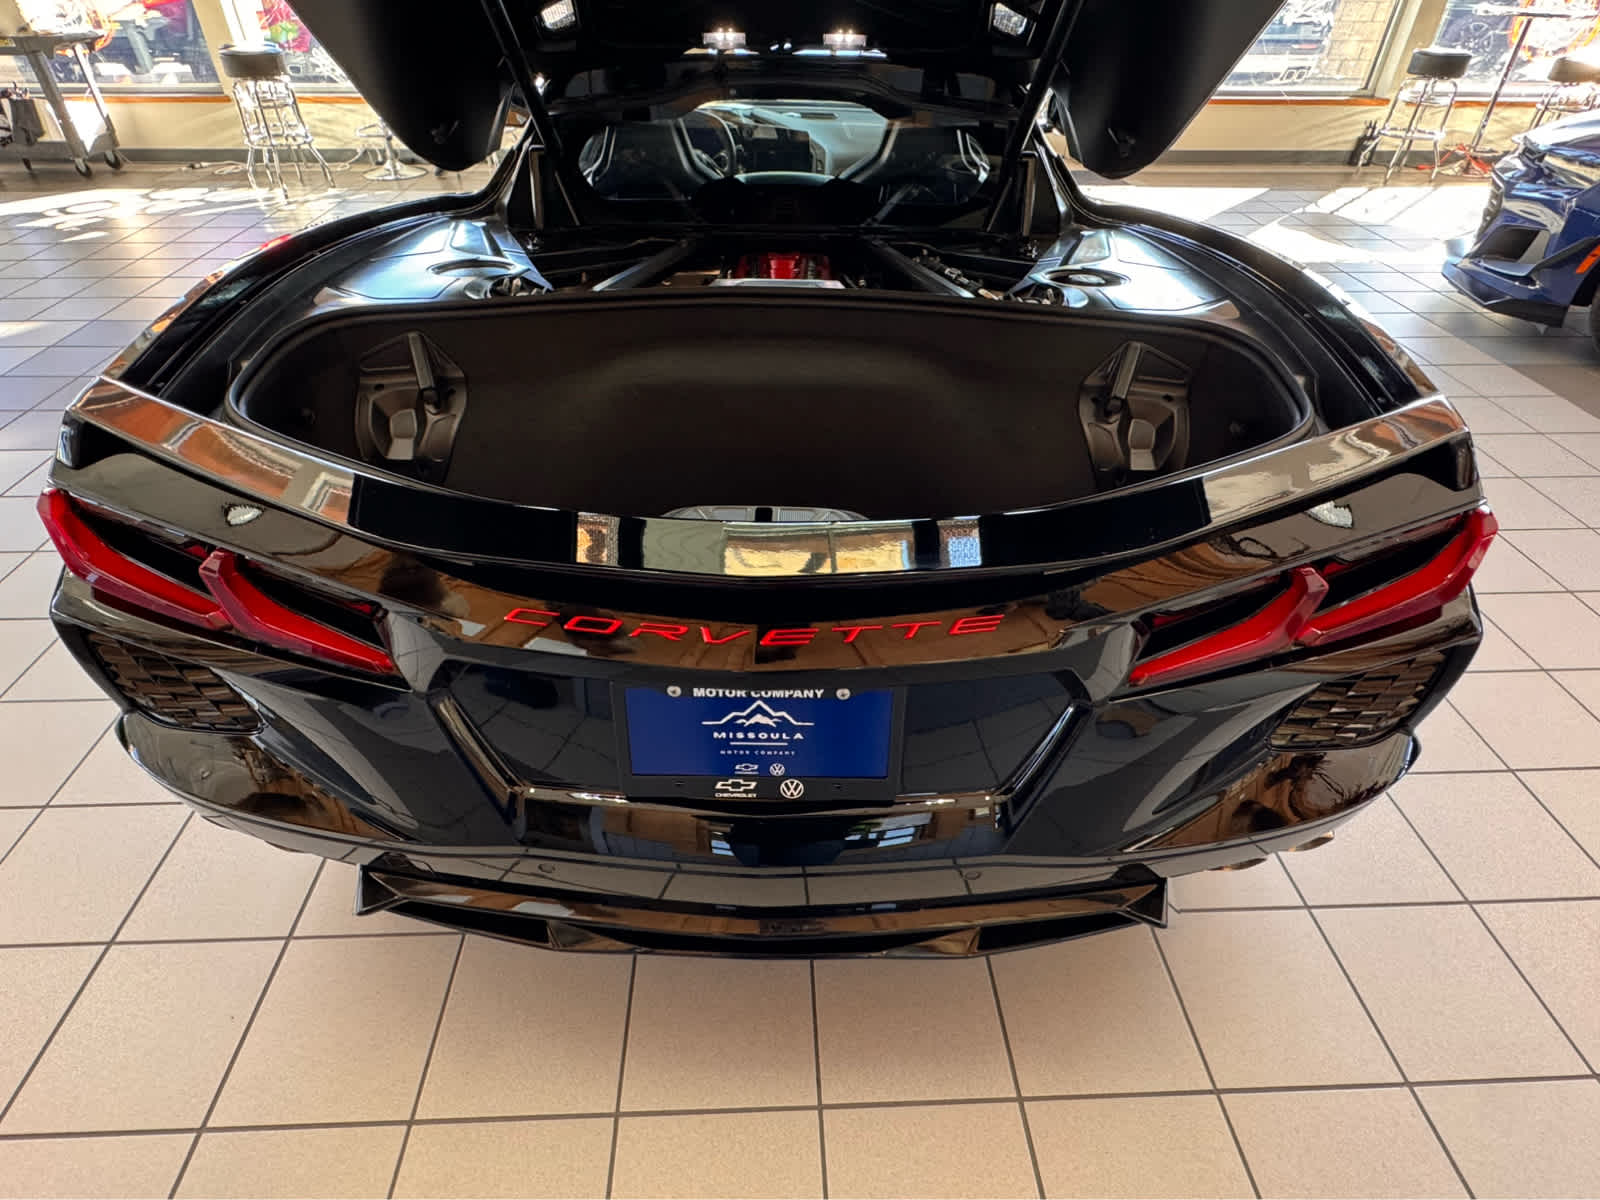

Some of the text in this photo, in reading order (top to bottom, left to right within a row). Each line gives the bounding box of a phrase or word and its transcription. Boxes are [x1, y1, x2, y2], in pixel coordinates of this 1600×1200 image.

[503, 607, 1005, 646] CORVETTE
[692, 687, 825, 699] MOTOR COMPANY
[712, 731, 804, 740] MISSOULA
